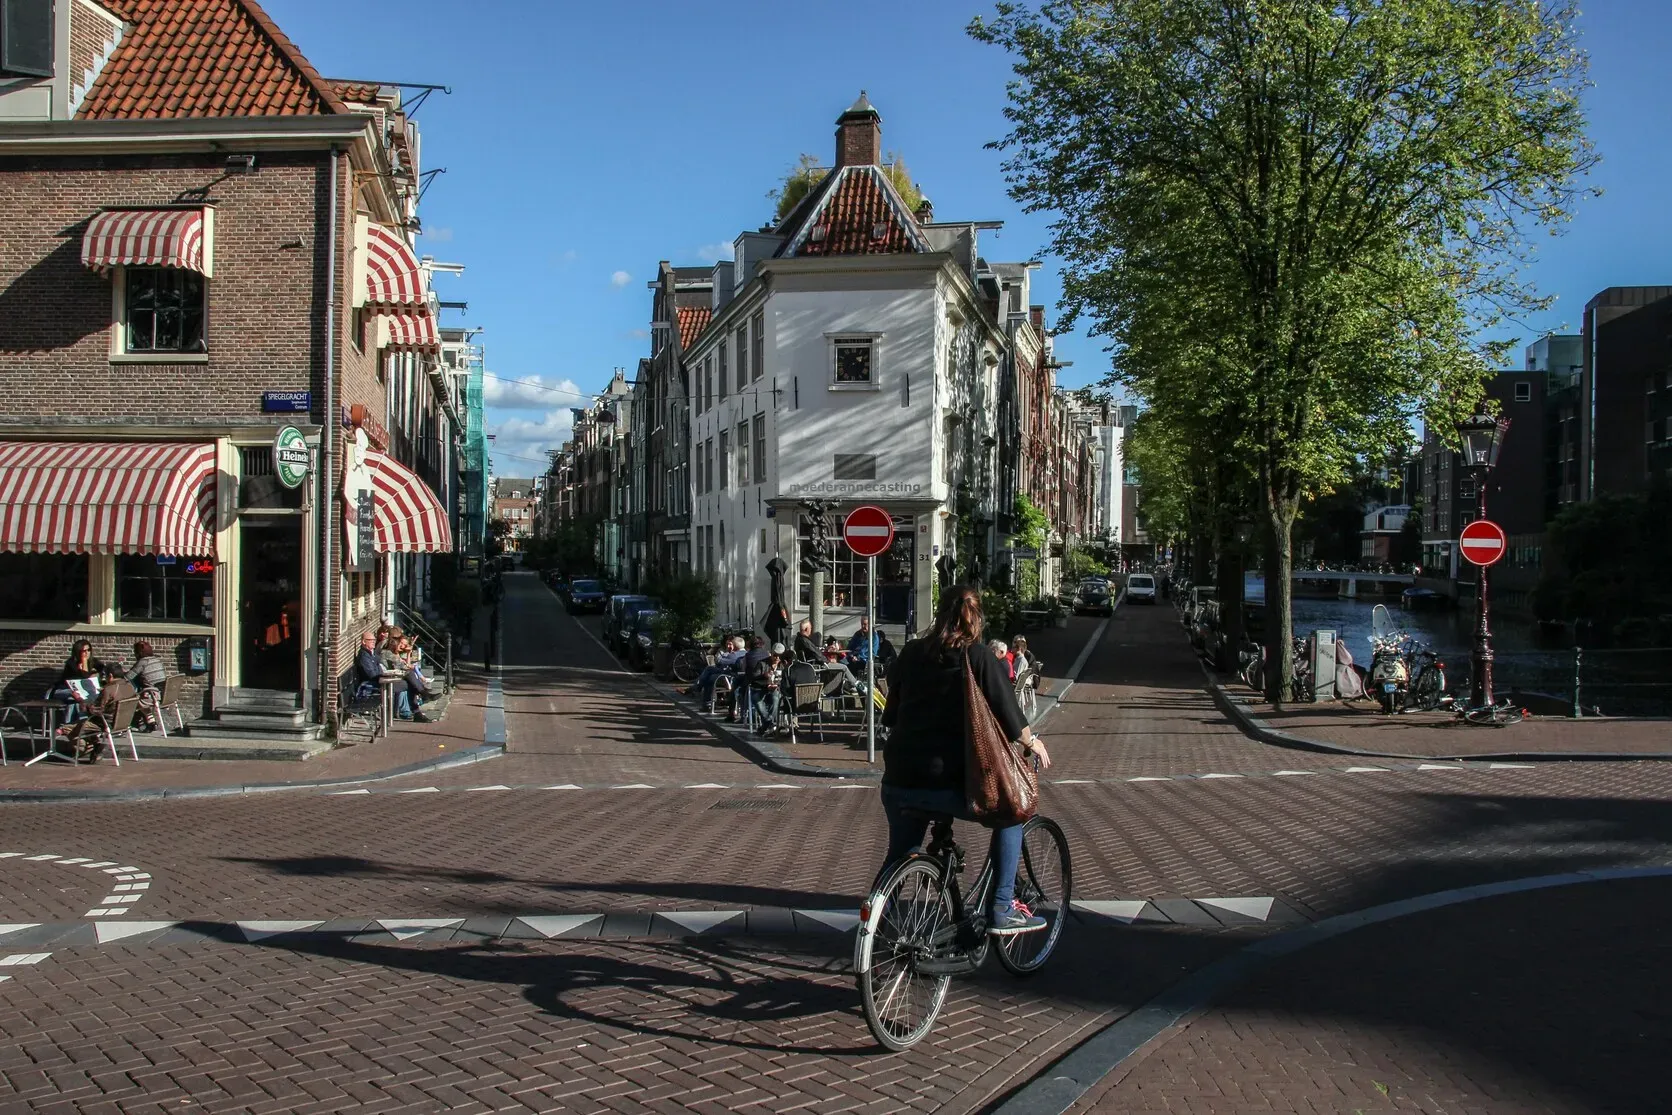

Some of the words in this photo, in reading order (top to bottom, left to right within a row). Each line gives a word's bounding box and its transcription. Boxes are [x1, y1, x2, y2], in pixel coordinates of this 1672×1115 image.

[267, 393, 308, 401] SPIEGELGRACHT
[789, 481, 921, 494] moederannecasting
[919, 553, 930, 561] 31
